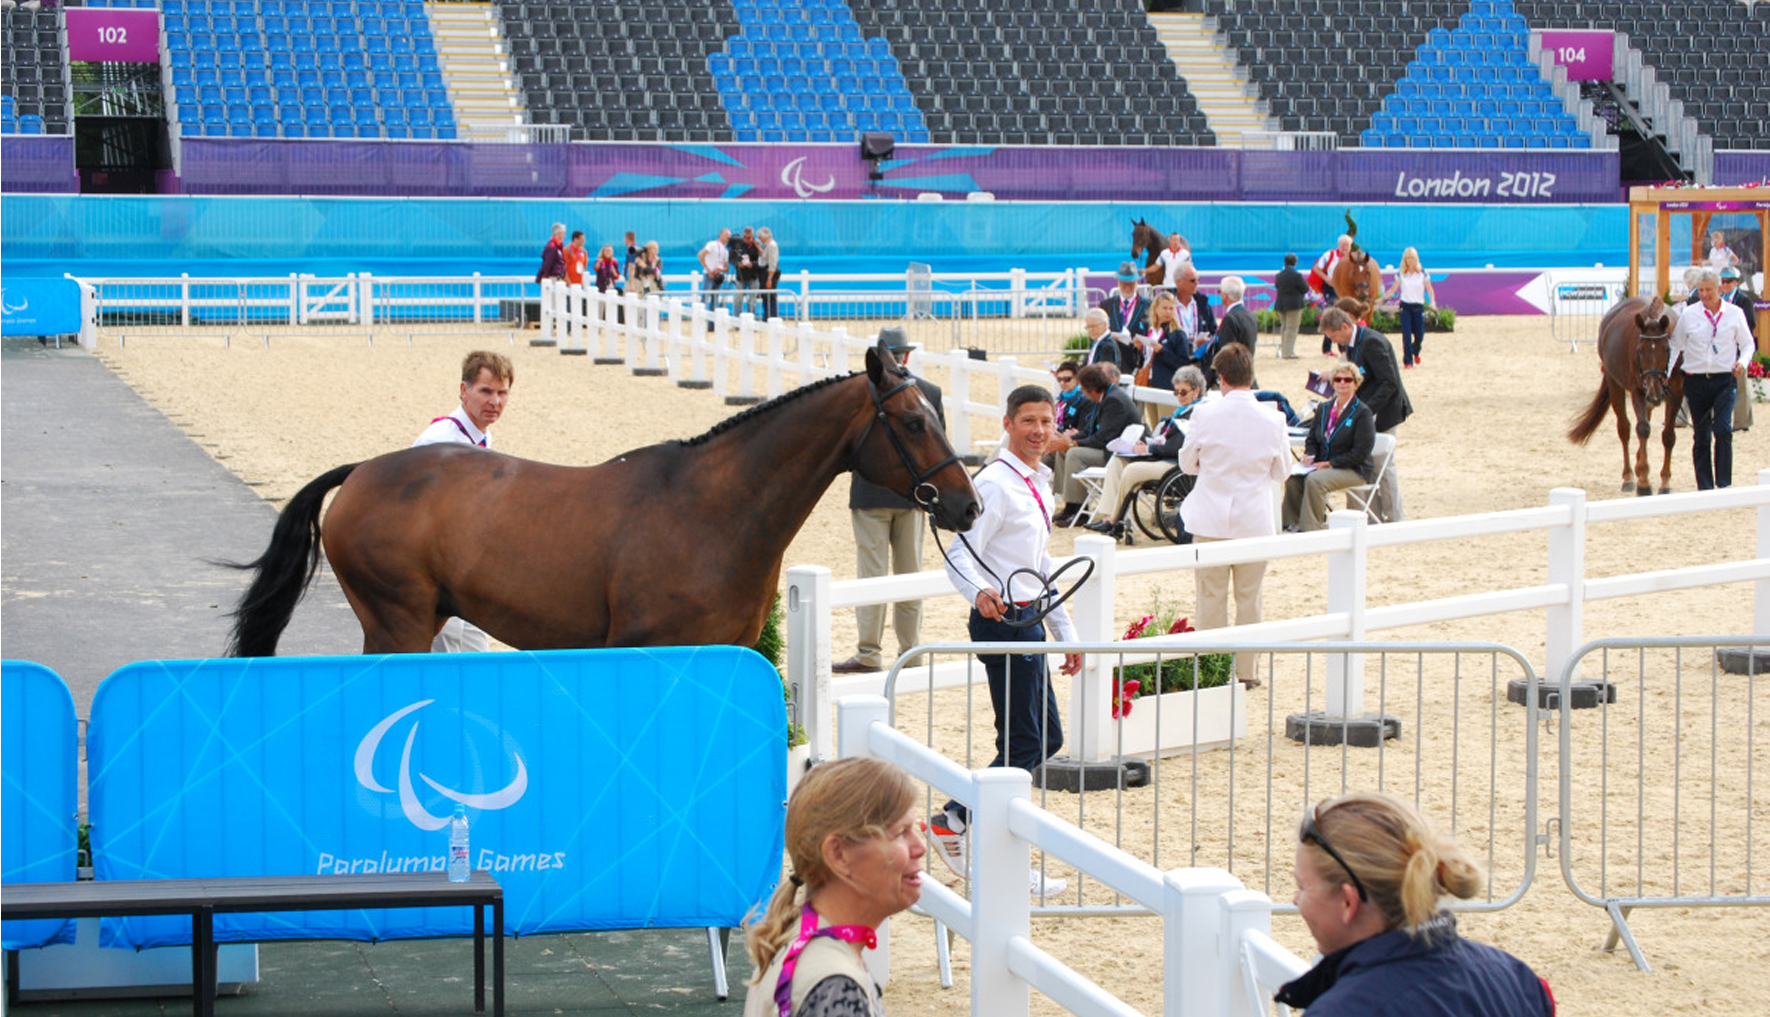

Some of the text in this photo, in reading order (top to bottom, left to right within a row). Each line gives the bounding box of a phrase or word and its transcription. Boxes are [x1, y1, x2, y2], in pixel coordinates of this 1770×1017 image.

[97, 26, 128, 44] 102
[1558, 46, 1587, 63] 104
[1395, 169, 1557, 198] London 2012
[317, 849, 448, 876] Paralymp
[476, 848, 566, 872] Games
